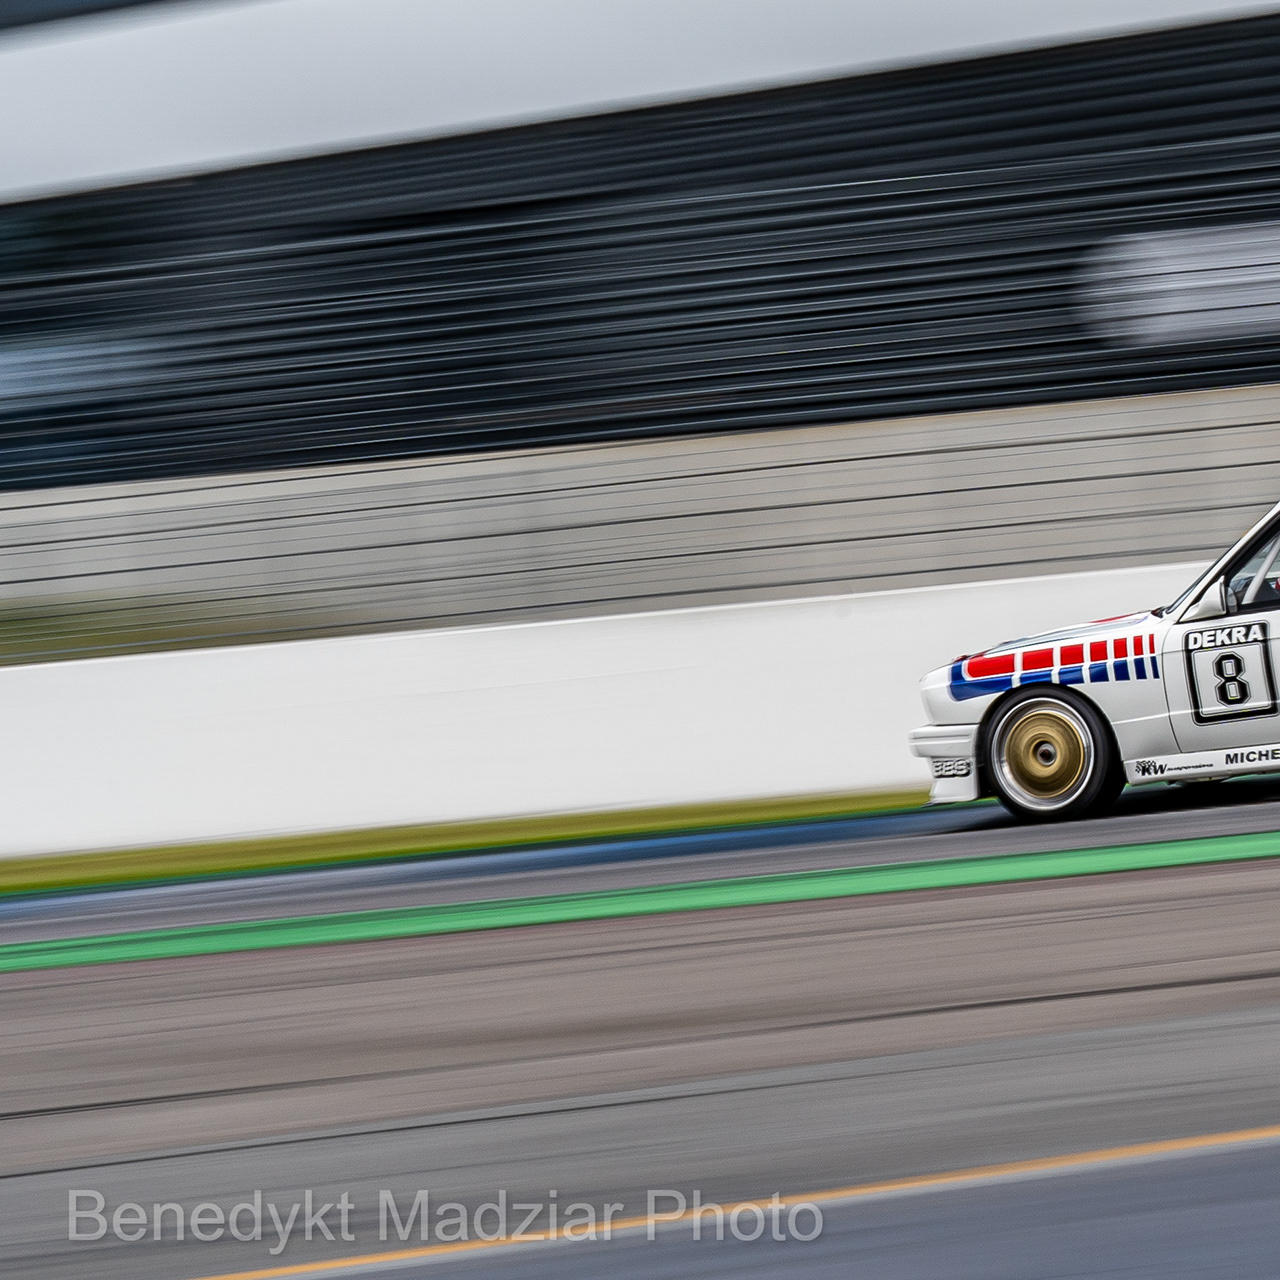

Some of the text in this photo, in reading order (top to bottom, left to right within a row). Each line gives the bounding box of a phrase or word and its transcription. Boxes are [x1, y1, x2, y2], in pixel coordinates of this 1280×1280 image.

[1188, 624, 1264, 650] DEKRA
[1212, 651, 1251, 707] 8
[1141, 763, 1167, 776] KW
